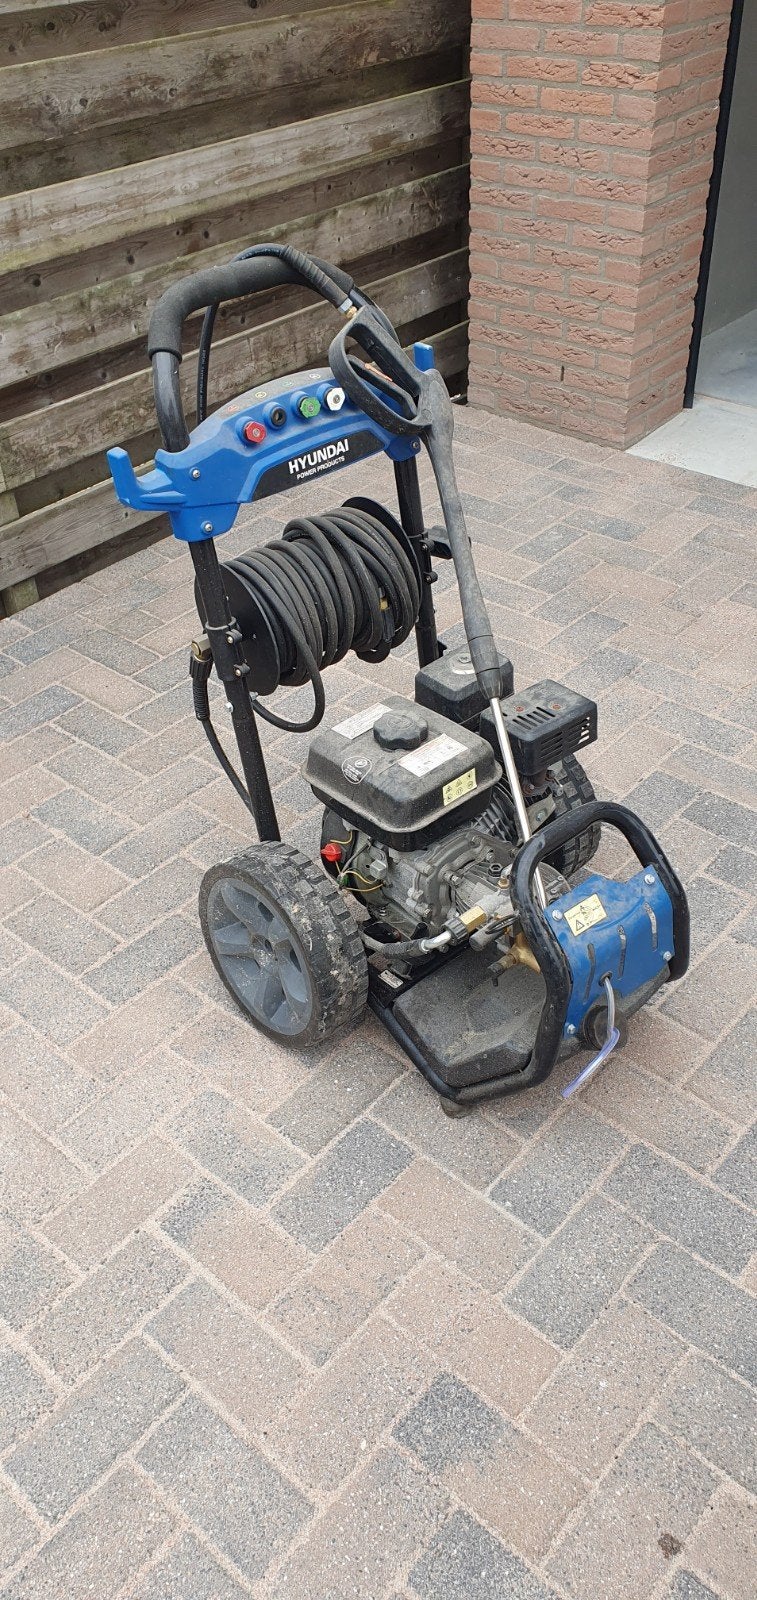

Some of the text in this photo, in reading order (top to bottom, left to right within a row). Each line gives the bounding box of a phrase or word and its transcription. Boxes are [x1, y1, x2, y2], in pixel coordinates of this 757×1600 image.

[288, 438, 349, 474] HYUNDAI
[296, 455, 345, 480] POWER PRODUCTS
